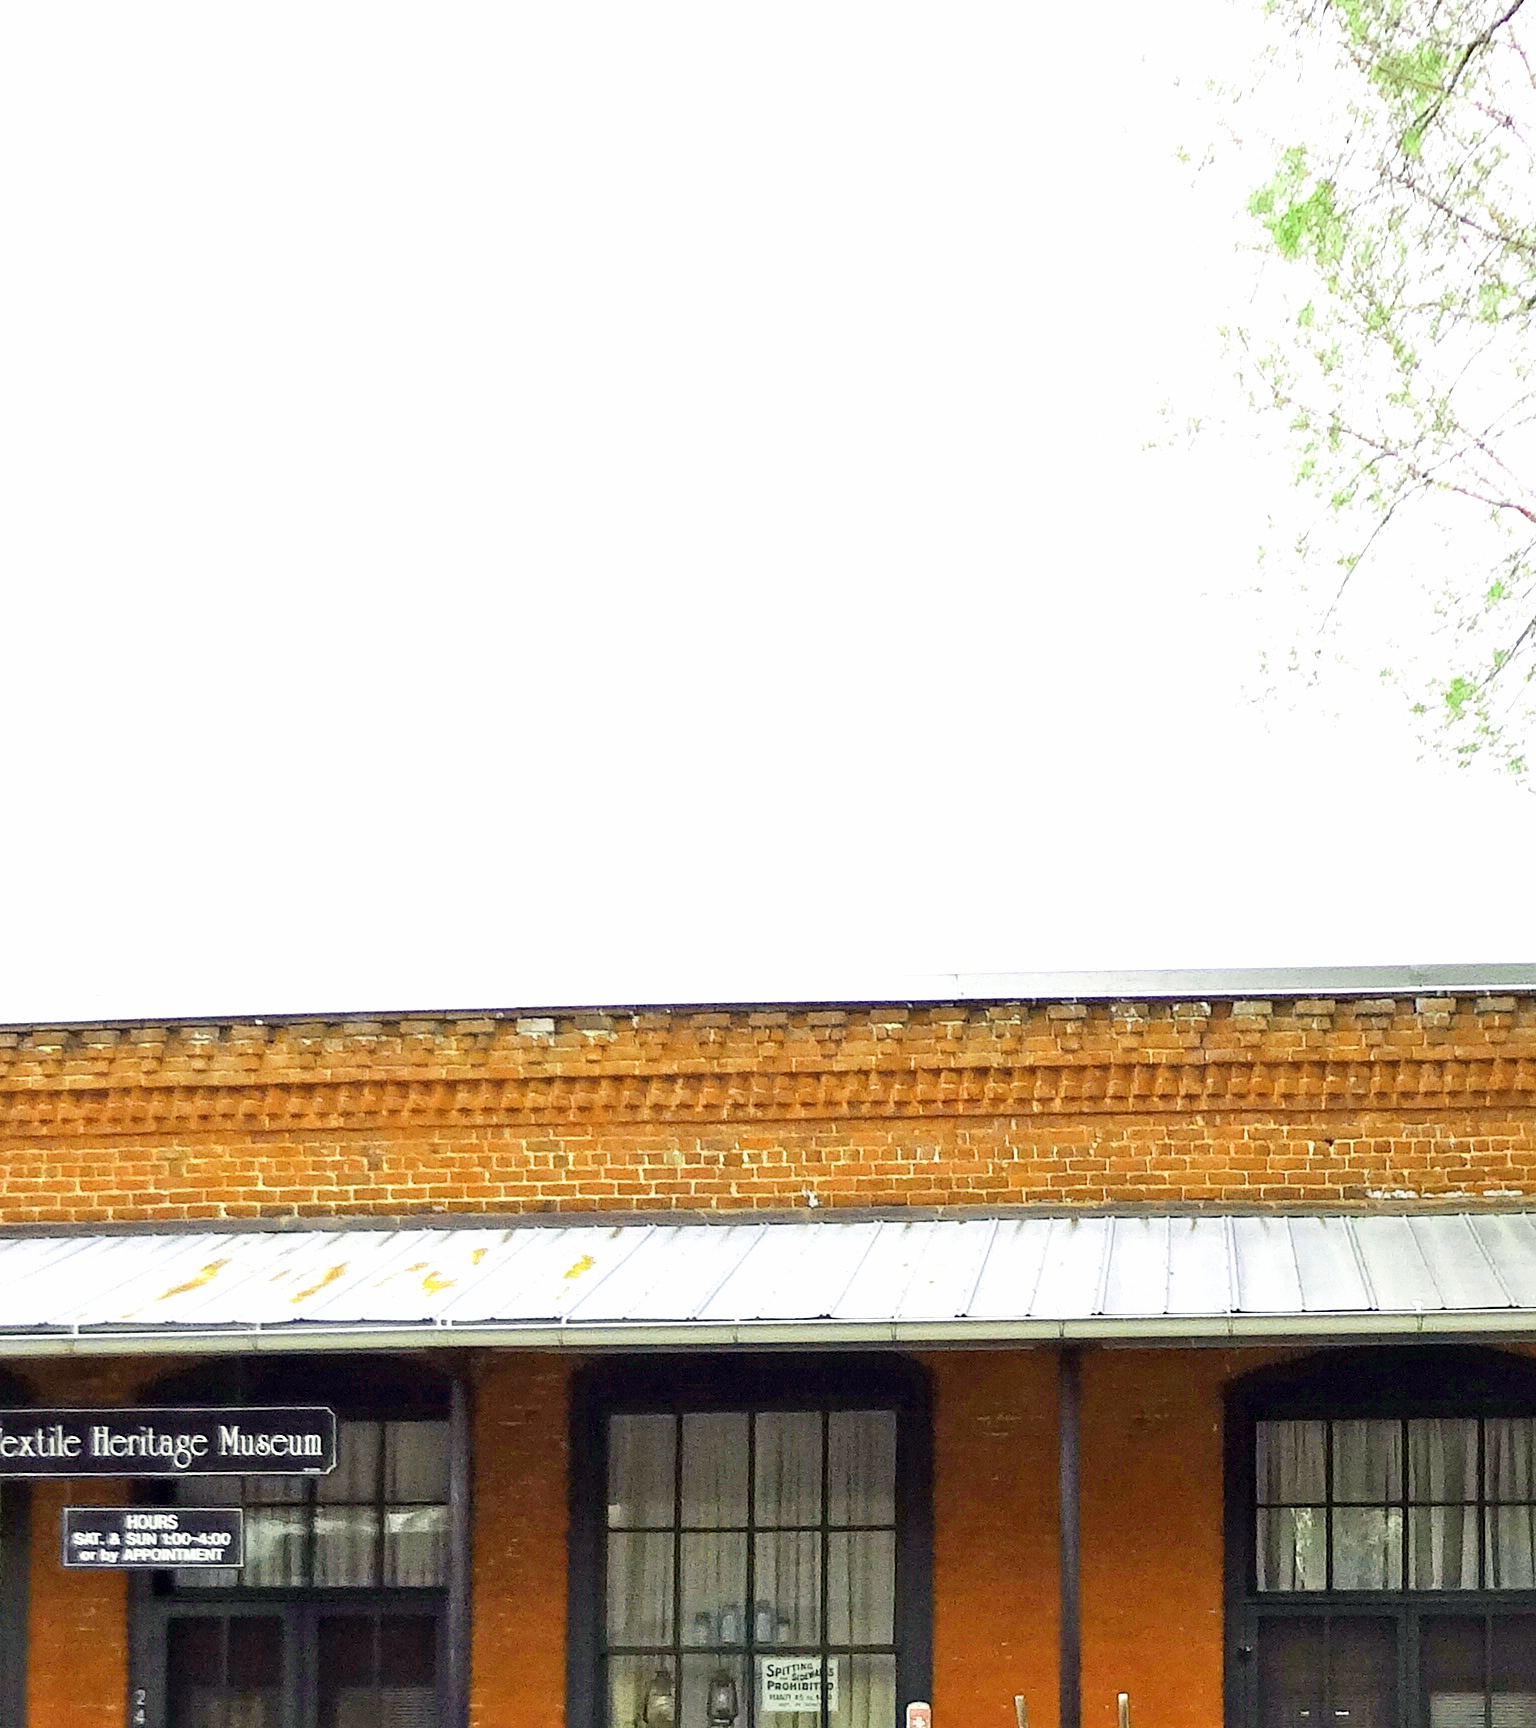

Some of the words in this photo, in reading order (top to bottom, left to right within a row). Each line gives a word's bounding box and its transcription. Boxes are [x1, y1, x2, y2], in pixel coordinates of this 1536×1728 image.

[93, 1426, 208, 1468] Heritage
[218, 1425, 322, 1457] Museum
[125, 1514, 179, 1530] HOURS
[72, 1532, 105, 1546] SAT.
[108, 1532, 121, 1546] &
[125, 1532, 158, 1546] SUN
[79, 1551, 98, 1562] or
[100, 1548, 119, 1563] by
[122, 1548, 225, 1562] APPOINTMENT
[767, 1680, 834, 1691] PROHIBITD
